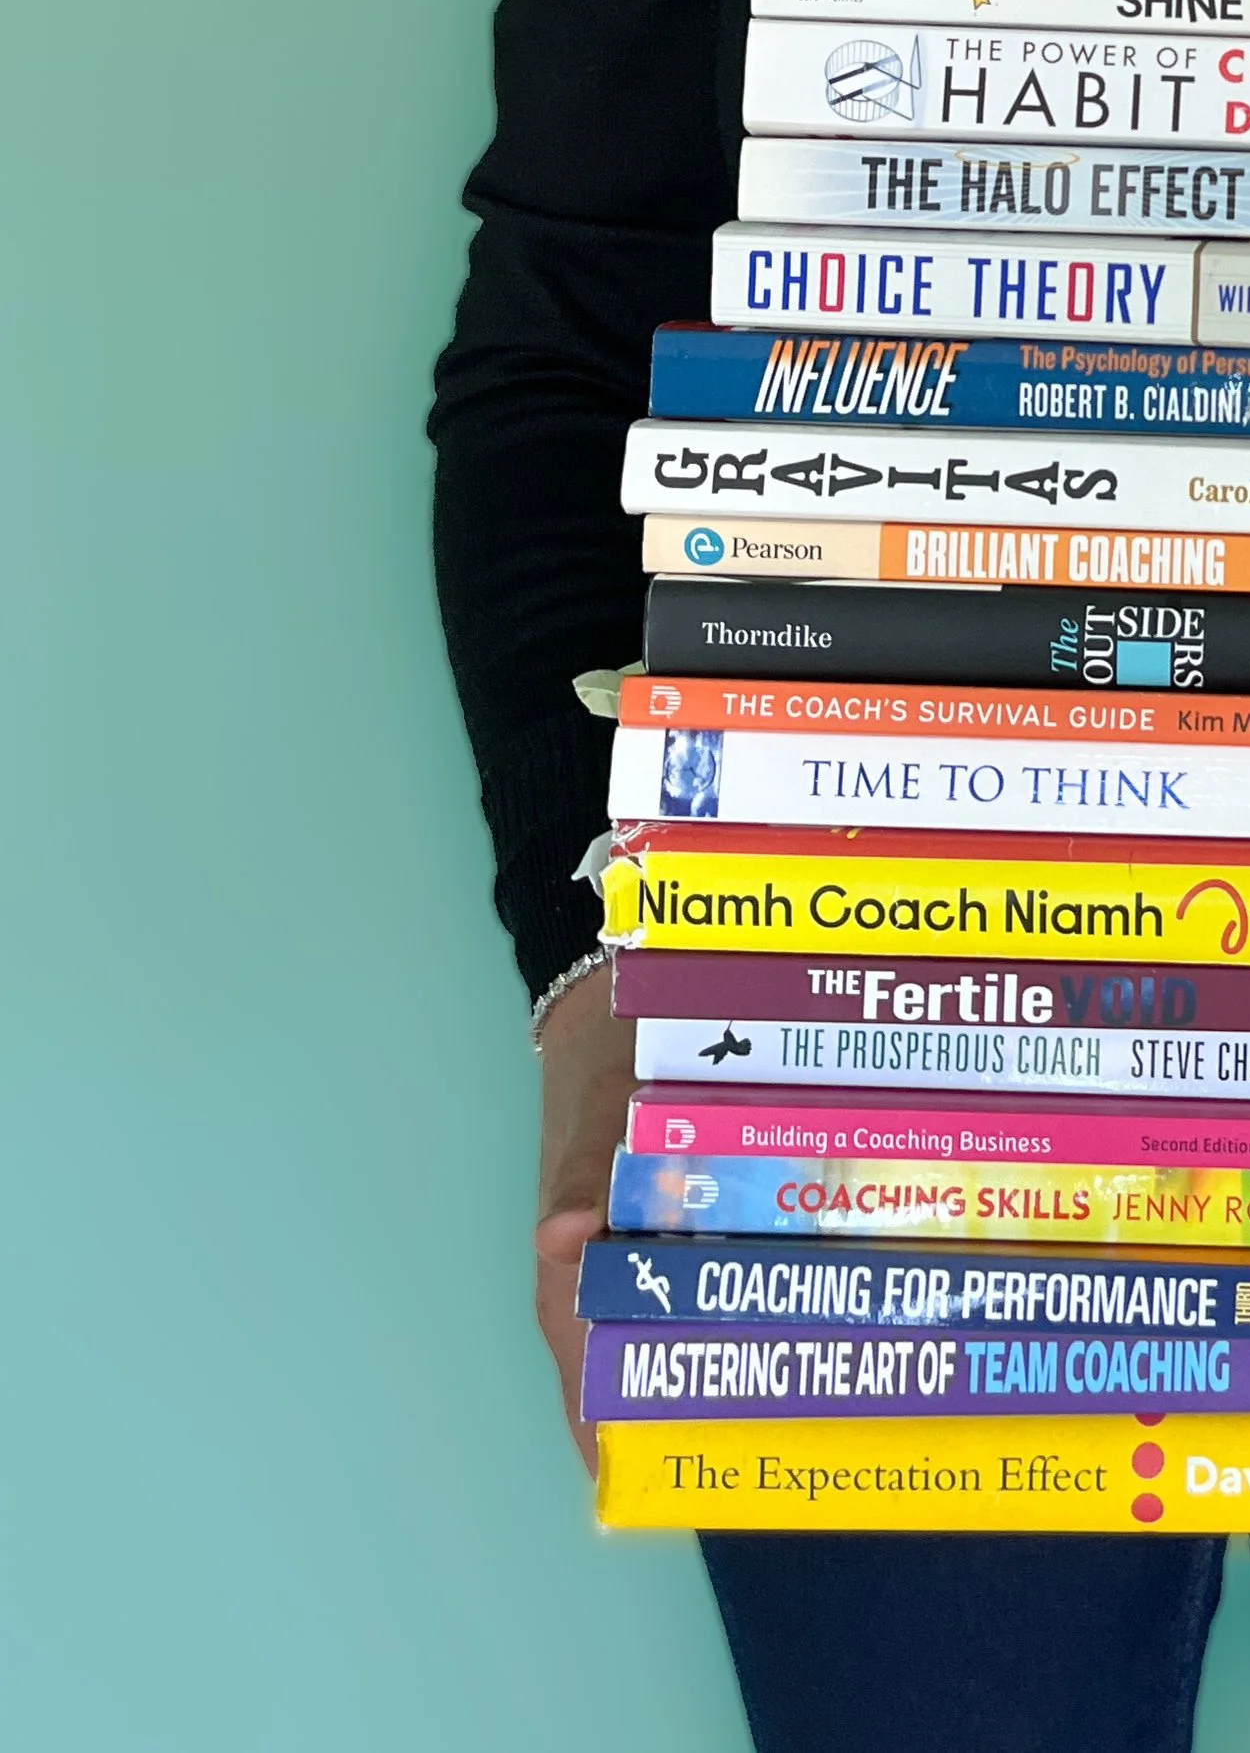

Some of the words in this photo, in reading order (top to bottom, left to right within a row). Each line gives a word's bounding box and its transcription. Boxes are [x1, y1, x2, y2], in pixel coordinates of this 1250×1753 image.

[946, 38, 1003, 62] THE
[1023, 41, 1138, 67] POWER
[1156, 46, 1197, 69] OF
[941, 65, 1197, 132] HABIT
[861, 156, 943, 211] THE
[960, 160, 1071, 215] HALO
[1090, 164, 1245, 221] EFFECT
[747, 250, 934, 316] CHOICE
[967, 257, 1167, 325] THEORY
[753, 339, 969, 416] INFLUENCE
[1019, 345, 1057, 371] The
[1061, 347, 1172, 379] Psychology
[1177, 350, 1199, 374] of
[1018, 382, 1107, 420] ROBERT
[1114, 385, 1135, 420] B.
[1143, 385, 1248, 426] CIALDINI,
[654, 447, 1117, 505] GRAVITAS
[731, 536, 823, 561] Pearson
[906, 530, 1058, 581] BRILLIANT
[1068, 534, 1226, 586] COACHING
[702, 622, 832, 648] Thorndike
[1050, 617, 1079, 673] The
[722, 693, 774, 717] THE
[786, 695, 908, 722] COACH'S
[919, 700, 1057, 727] SURVIVAL
[1069, 705, 1154, 731] GUIDE
[1178, 710, 1224, 733] Kim
[802, 759, 921, 800] TIME
[939, 764, 1005, 803] TO
[1022, 767, 1190, 809] THINK
[638, 880, 793, 927] Niamh
[809, 884, 987, 933] Coach
[1005, 889, 1163, 937] Niamh
[808, 969, 860, 995] THE
[862, 970, 1053, 1023] Fertile
[1059, 975, 1197, 1026] VOID
[780, 1027, 824, 1067] THE
[837, 1029, 1004, 1074] PROSPEROUS
[1017, 1035, 1101, 1077] COACH
[1131, 1039, 1205, 1080] STEVE
[741, 1125, 828, 1154] Building
[834, 1132, 847, 1147] a
[853, 1128, 953, 1160] Coaching
[960, 1131, 1052, 1153] Business
[1141, 1136, 1198, 1153] Second
[776, 1182, 966, 1216] COACHING
[976, 1187, 1091, 1220] SKILLS
[1112, 1193, 1210, 1224] JENNY
[697, 1261, 872, 1315] COACHING
[883, 1267, 950, 1319] FOR
[961, 1270, 1218, 1327] PERFORMANCE
[621, 1341, 790, 1398] MASTERING
[796, 1341, 852, 1397] THE
[855, 1341, 917, 1396] ART
[916, 1341, 957, 1395] OF
[965, 1341, 1058, 1395] TEAM
[1065, 1340, 1230, 1393] COACHING
[663, 1454, 740, 1490] The
[755, 1455, 982, 1501] Expectation
[998, 1454, 1107, 1493] Effect
